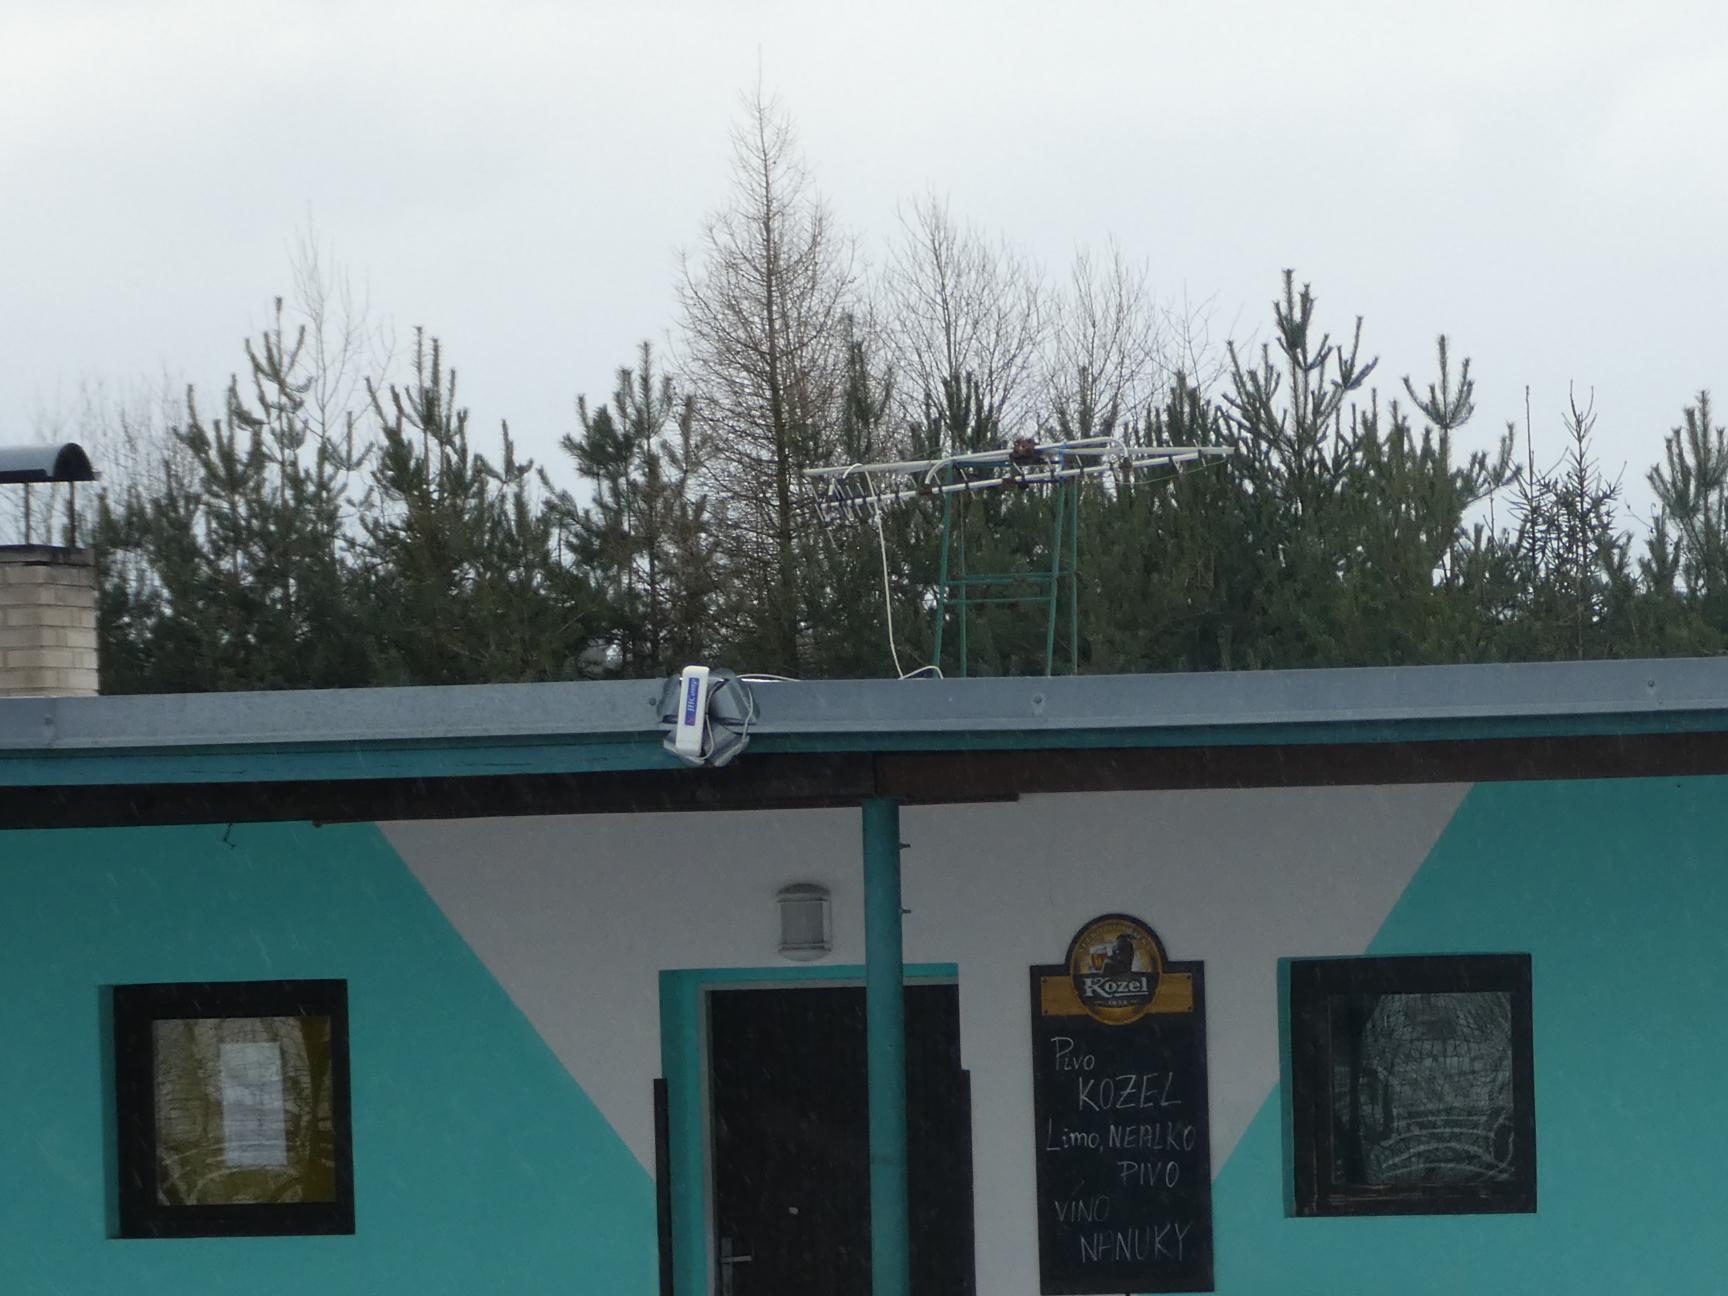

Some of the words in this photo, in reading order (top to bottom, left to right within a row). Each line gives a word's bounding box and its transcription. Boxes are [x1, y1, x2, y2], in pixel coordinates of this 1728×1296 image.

[1083, 976, 1149, 998] Kozel
[1050, 1036, 1096, 1071] Pivo
[1078, 1071, 1183, 1112] KOZEL
[1109, 1122, 1196, 1151] NEALKO
[1117, 1160, 1180, 1188] PIVO
